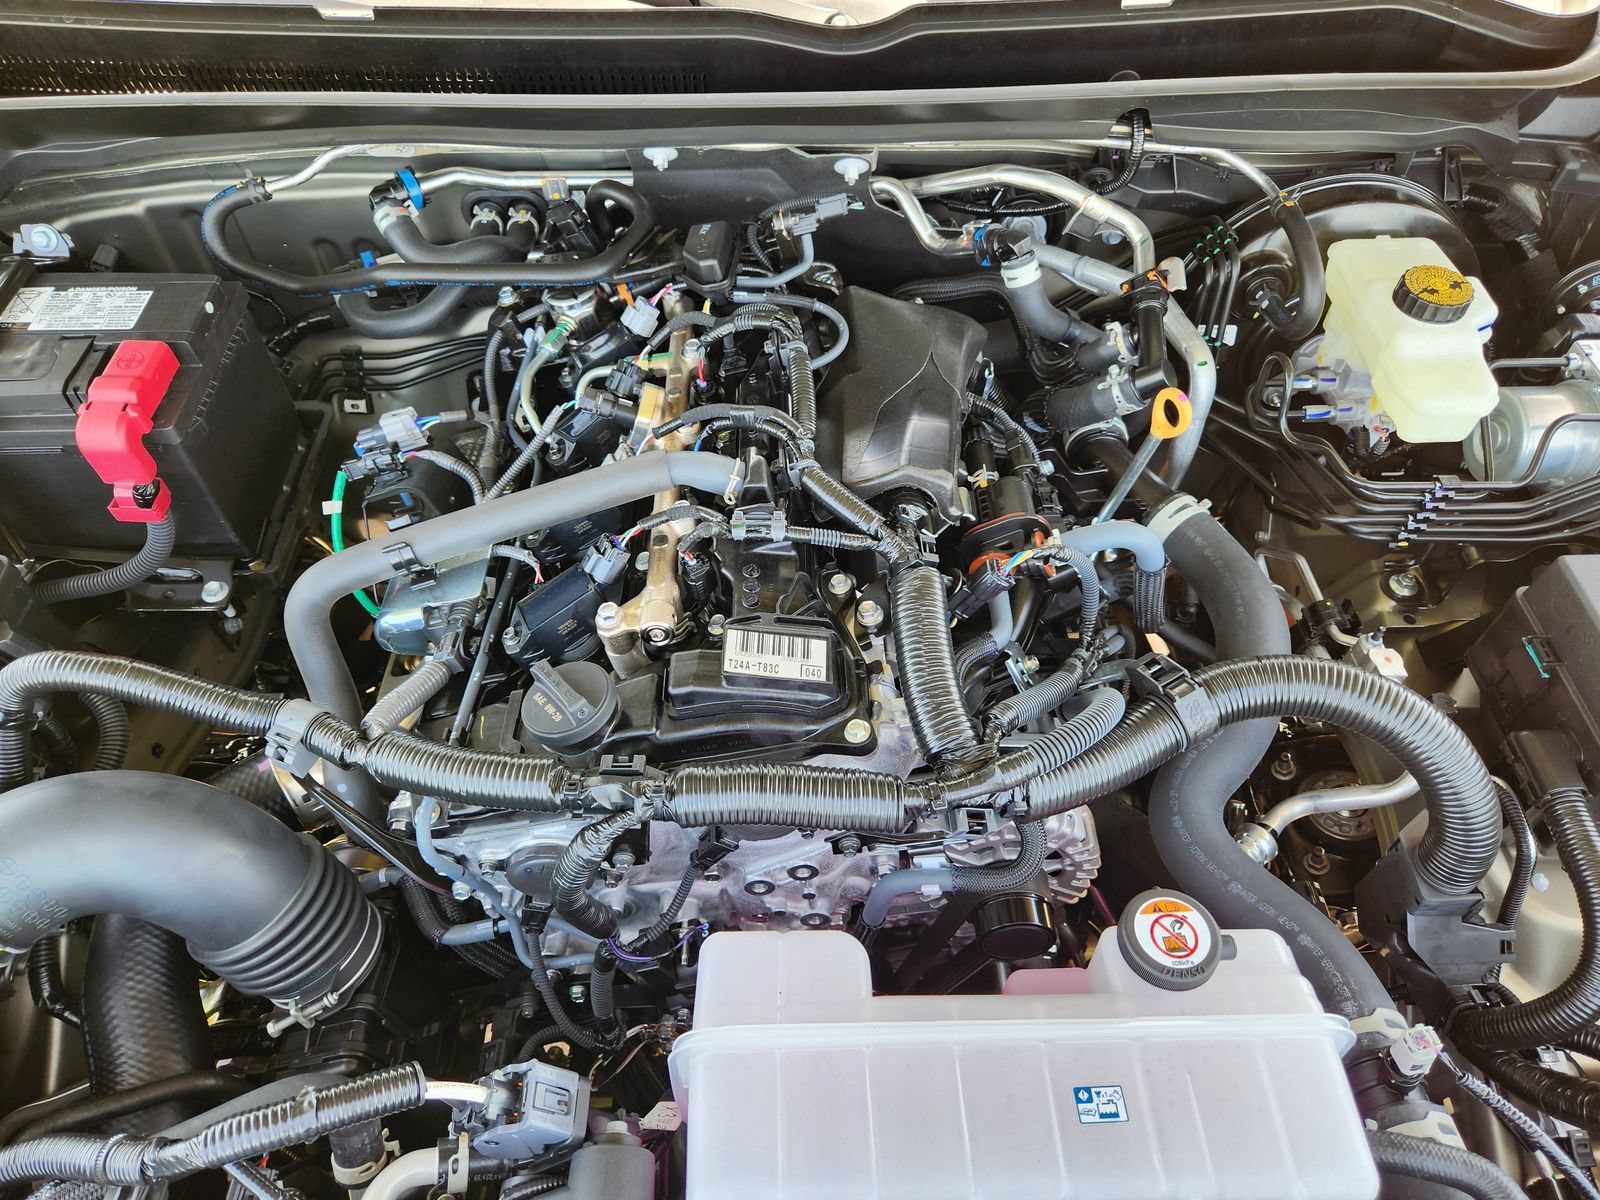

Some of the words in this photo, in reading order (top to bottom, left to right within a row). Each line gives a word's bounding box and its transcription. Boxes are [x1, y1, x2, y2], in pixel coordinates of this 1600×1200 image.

[728, 658, 780, 674] T24A-T83C
[805, 668, 822, 678] 040
[532, 692, 547, 706] SAE
[543, 703, 563, 722] 0W-20
[1162, 965, 1207, 979] DENSO
